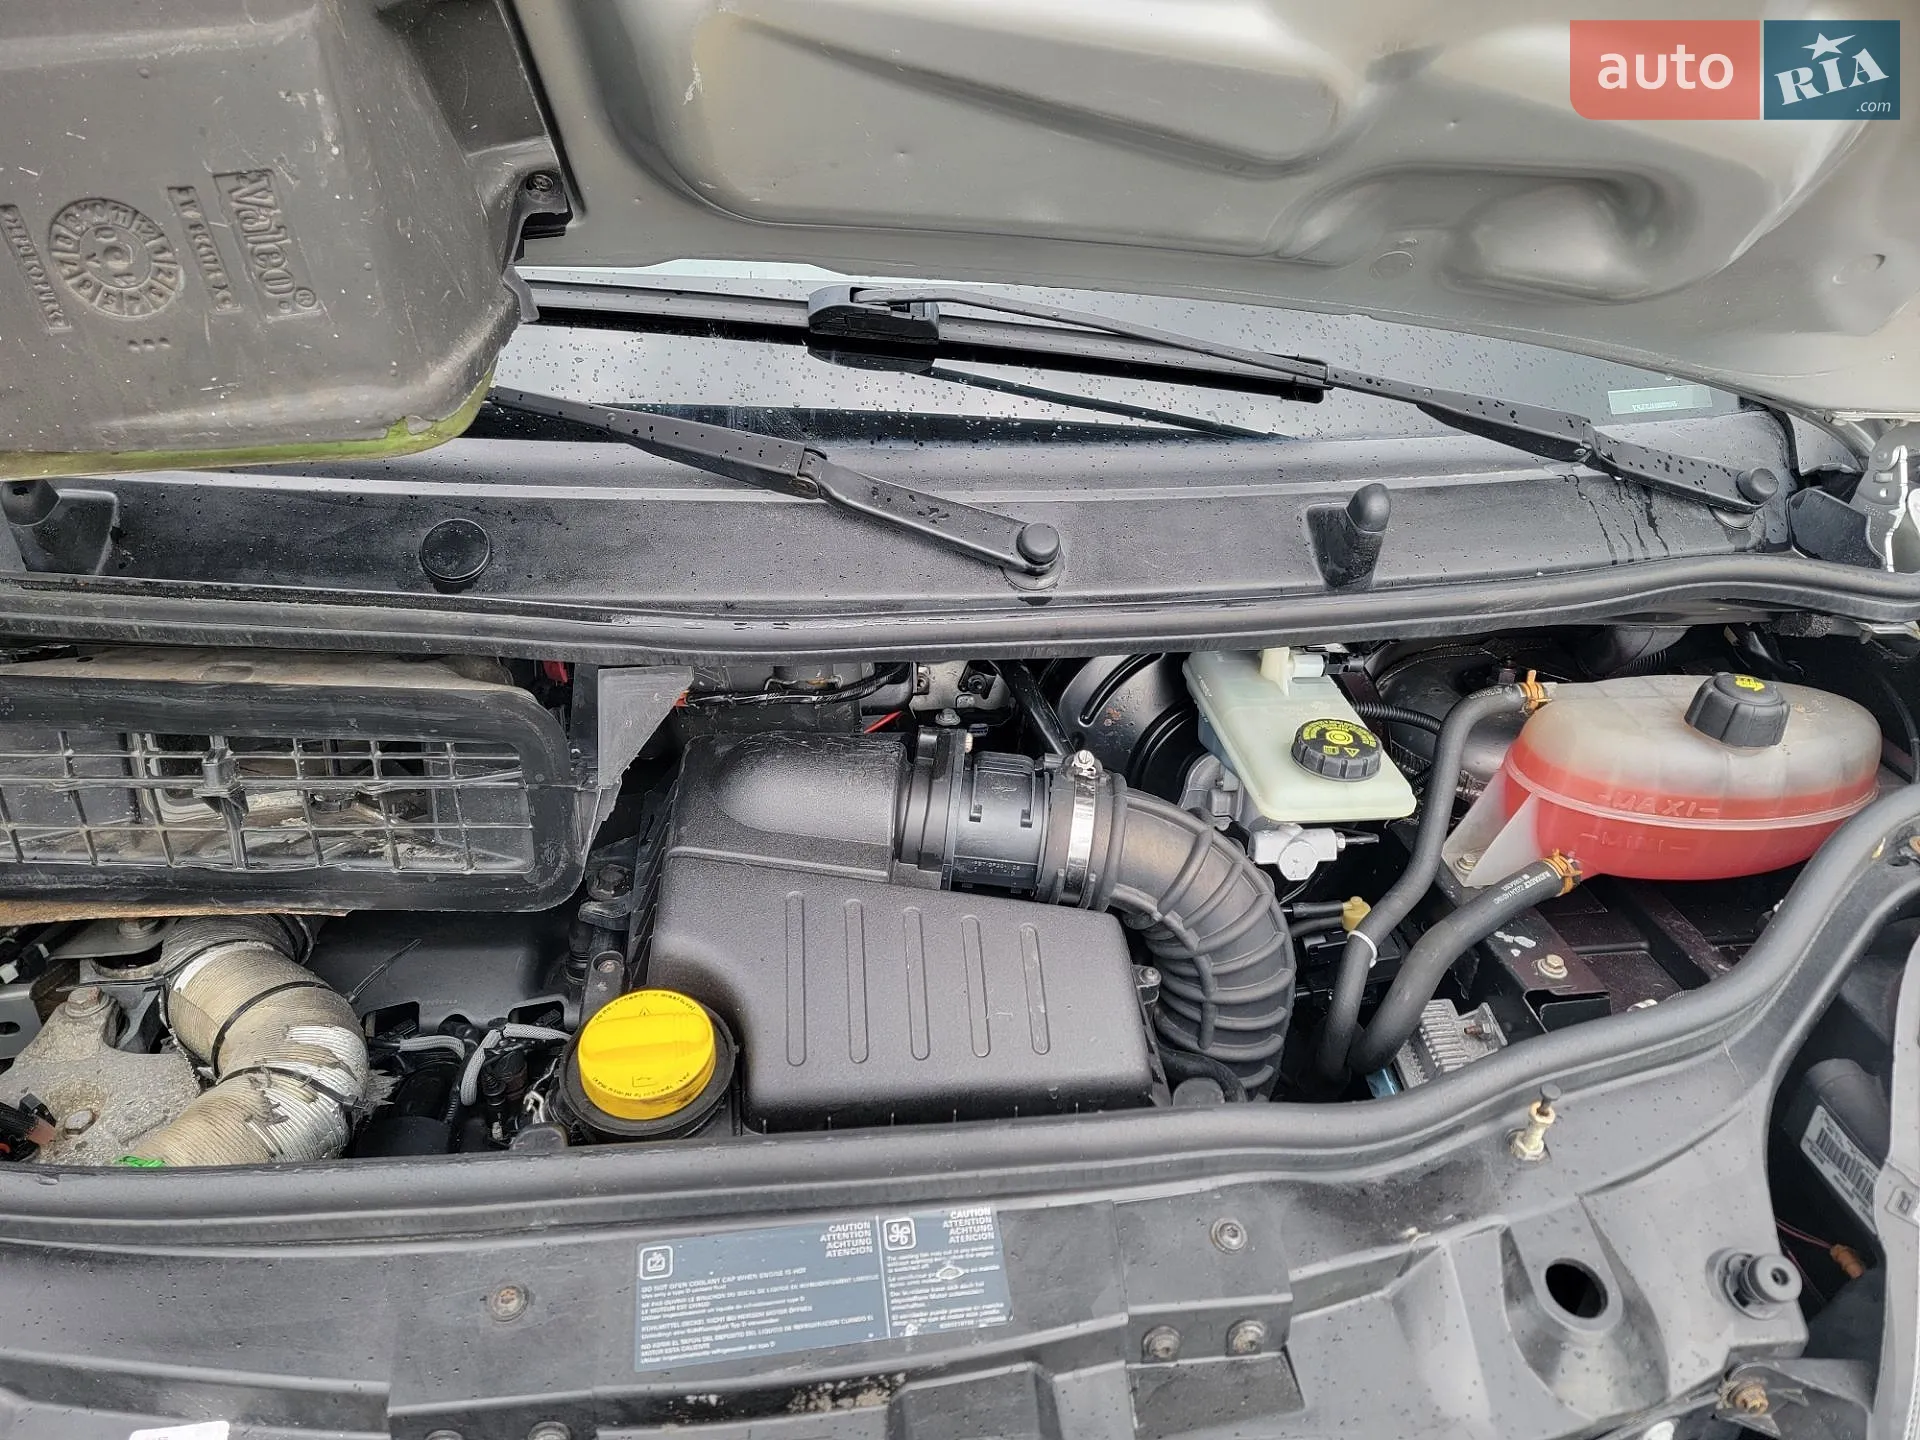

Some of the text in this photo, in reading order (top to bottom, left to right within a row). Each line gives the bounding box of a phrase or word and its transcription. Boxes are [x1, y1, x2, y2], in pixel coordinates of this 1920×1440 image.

[950, 1207, 991, 1219] CAUTION
[828, 1221, 871, 1232] CAUTION
[943, 1216, 992, 1229] ATTENTION
[820, 1230, 872, 1242] ATTENTION
[949, 1224, 993, 1236] ACHTUNG
[826, 1237, 873, 1250] ACHTUNG
[948, 1232, 995, 1244] ATENCION
[825, 1246, 873, 1258] ATENCION
